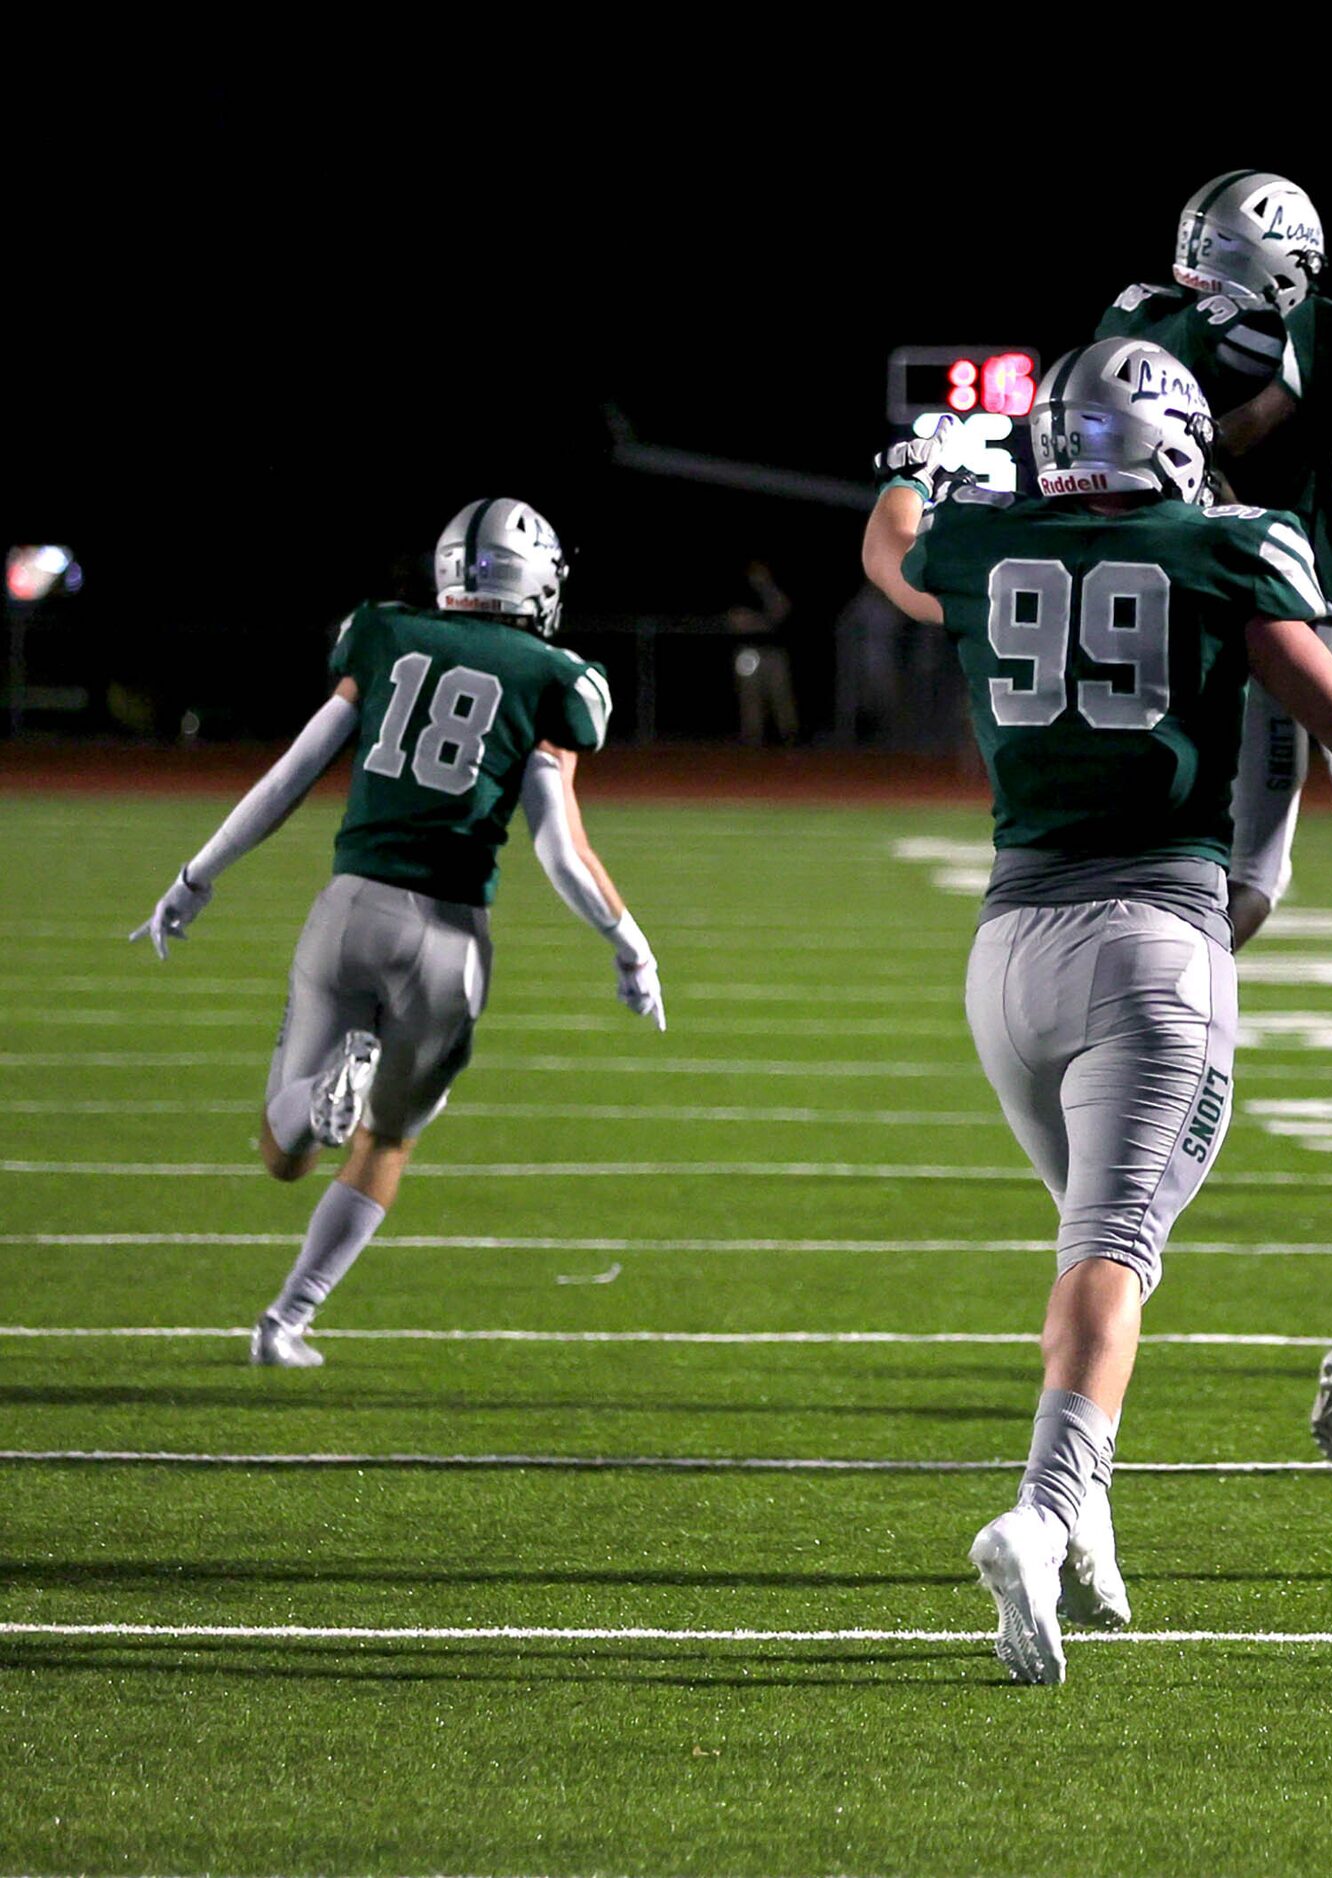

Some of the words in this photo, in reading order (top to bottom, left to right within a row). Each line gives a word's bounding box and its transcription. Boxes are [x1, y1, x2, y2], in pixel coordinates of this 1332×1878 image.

[1041, 474, 1108, 495] Riddell
[988, 557, 1171, 730] 99
[363, 651, 503, 795] 18
[1182, 1066, 1229, 1164] LIONS
